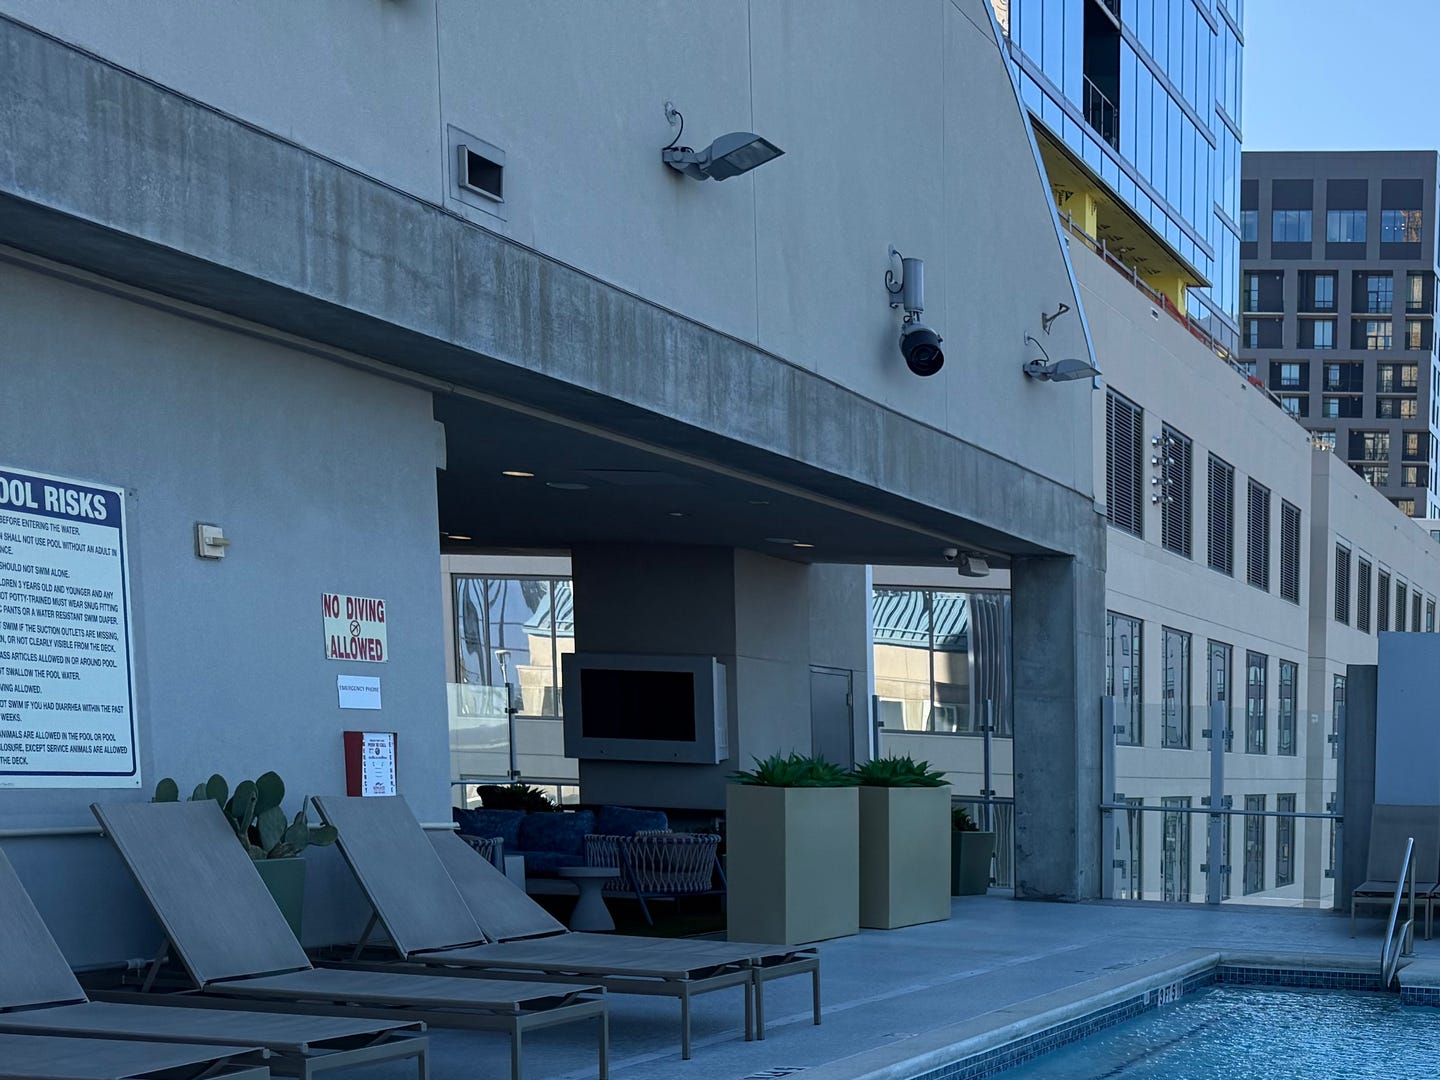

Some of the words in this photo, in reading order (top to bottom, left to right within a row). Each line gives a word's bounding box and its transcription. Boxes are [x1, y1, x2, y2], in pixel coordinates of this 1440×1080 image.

[44, 486, 107, 520] RISKS
[22, 519, 49, 530] ENTERING
[50, 524, 60, 532] THE
[61, 525, 80, 536] WATER.
[4, 532, 21, 542] SHALL
[22, 535, 34, 544] NOT
[35, 537, 46, 546] USE
[47, 539, 62, 548] POOL
[63, 542, 86, 552] WITHOUT
[87, 545, 94, 553] AN
[95, 546, 110, 555] ADULT
[0, 562, 21, 572] SHOULD
[22, 565, 34, 574] NOT
[36, 566, 50, 576] SWIM
[51, 568, 70, 578] ALONE.
[18, 580, 22, 588] 3
[23, 581, 40, 590] YEARS
[42, 583, 52, 592] OLD
[54, 585, 65, 594] AND
[66, 587, 91, 597] YOUNGER
[92, 590, 102, 598] AND
[103, 591, 114, 599] ANY
[52, 598, 67, 607] MUST
[68, 600, 84, 608] WEAR
[84, 602, 98, 610] SNUG
[100, 603, 118, 612] FITTING
[324, 594, 339, 618] NO
[346, 597, 384, 623] DIVING
[4, 605, 21, 615] PANTS
[22, 607, 30, 616] OR
[32, 608, 36, 616] A
[36, 609, 55, 618] WATER
[56, 611, 83, 621] RESISTANT
[84, 614, 98, 622] SWIM
[3, 621, 18, 630] SWIM
[19, 623, 24, 631] IF
[25, 624, 36, 633] THE
[36, 625, 60, 635] SUCTION
[61, 627, 85, 637] OUTLETS
[86, 630, 96, 638] ARE
[7, 636, 16, 644] OR
[17, 636, 28, 645] NOT
[29, 637, 52, 648] CLEARLY
[54, 640, 73, 649] VISIBLE
[74, 641, 90, 650] FROM
[90, 643, 100, 651] THE
[331, 635, 382, 661] ALLOWED
[12, 652, 37, 662] ARTICLES
[39, 654, 64, 664] ALLOWED
[65, 656, 70, 664] IN
[71, 656, 79, 665] OR
[80, 658, 102, 667] AROUND
[6, 667, 33, 677] SWALLOW
[35, 670, 45, 678] THE
[46, 670, 61, 679] POOL
[14, 684, 42, 694] ALLOWED.
[8, 700, 24, 709] SWIM
[24, 701, 29, 709] IF
[30, 701, 42, 710] YOU
[43, 702, 54, 710] HAD
[56, 702, 82, 712] DIARRHEA
[82, 704, 100, 712] WITHIN
[101, 704, 111, 713] THE
[112, 705, 124, 713] PAST
[24, 731, 34, 739] ARE
[36, 731, 61, 740] ALLOWED
[62, 732, 67, 740] IN
[68, 732, 78, 740] THE
[79, 733, 93, 741] POOL
[94, 733, 102, 741] OR
[102, 733, 116, 741] POOL
[25, 744, 46, 752] EXCEPT
[47, 744, 68, 753] SERVICE
[70, 745, 92, 753] ANIMALS
[104, 746, 127, 754] ALLOWED
[0, 756, 11, 765] THE
[12, 756, 28, 765] DECK.
